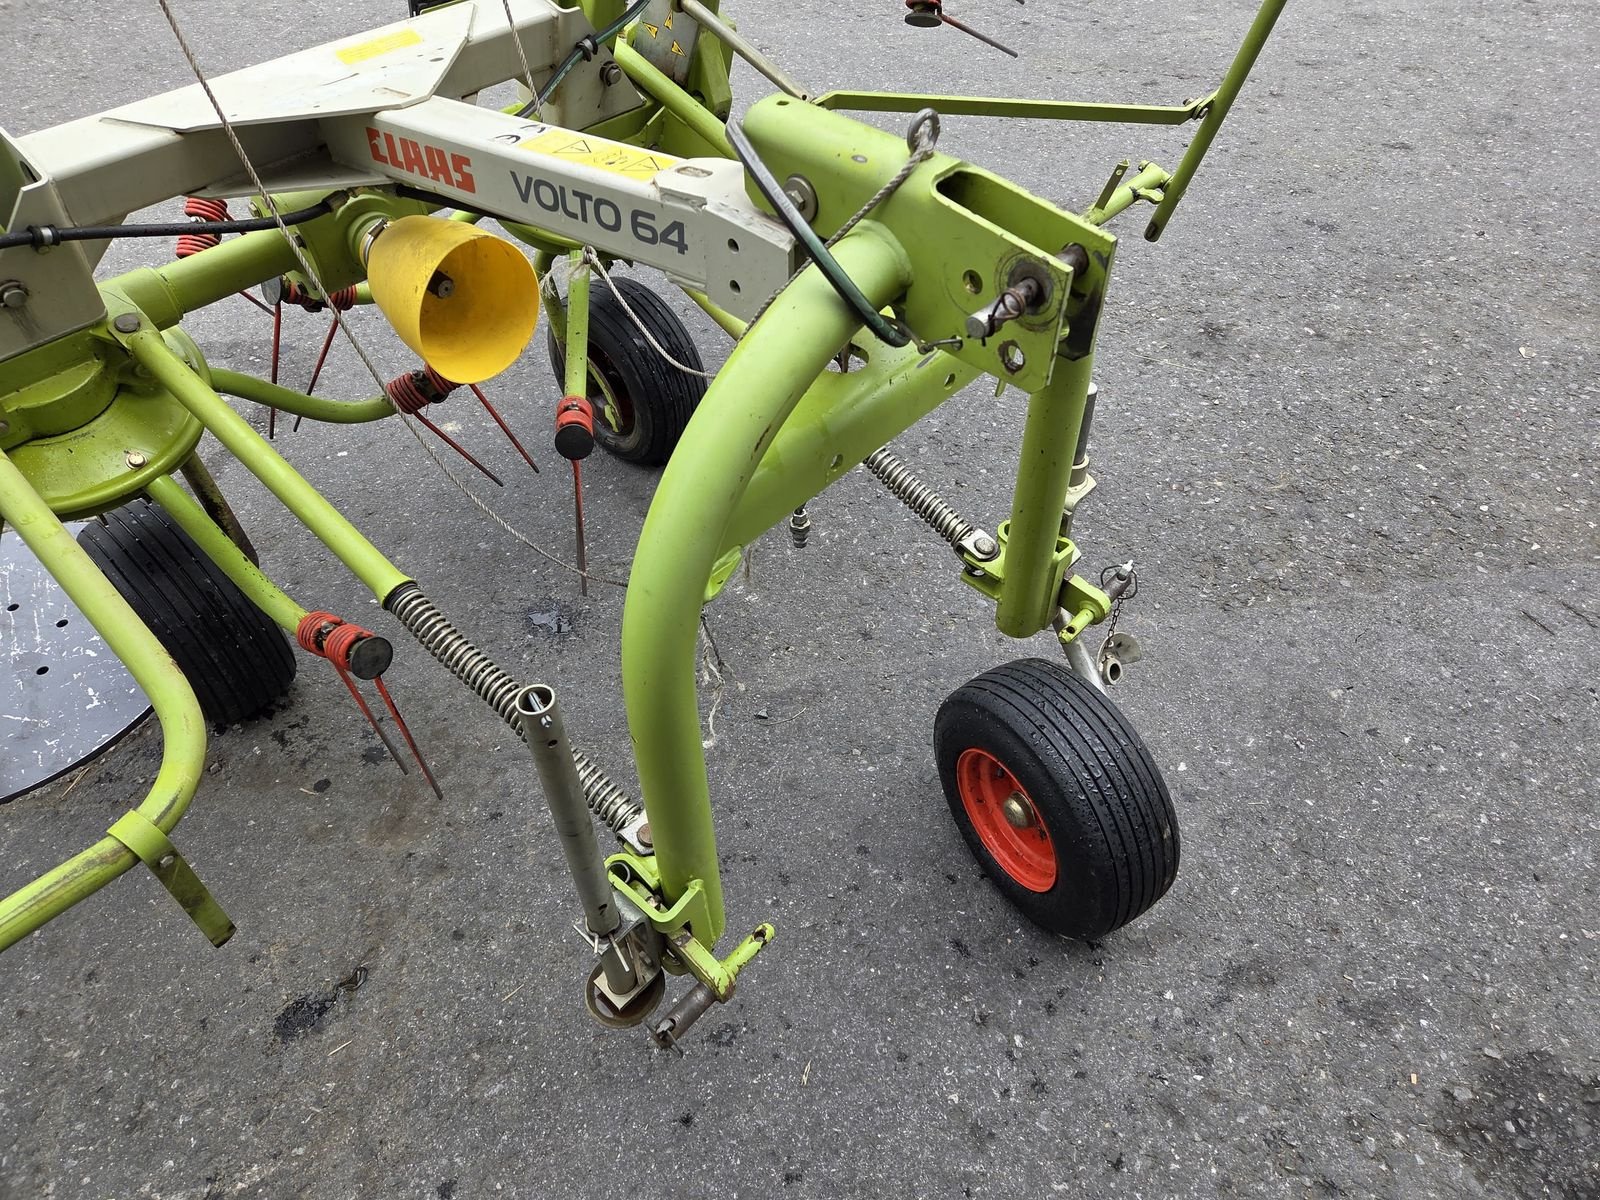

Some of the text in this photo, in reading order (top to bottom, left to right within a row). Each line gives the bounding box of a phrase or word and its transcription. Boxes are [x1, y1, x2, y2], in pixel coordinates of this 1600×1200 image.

[365, 126, 476, 194] CLAAS
[509, 170, 689, 255] VOLTO 64
